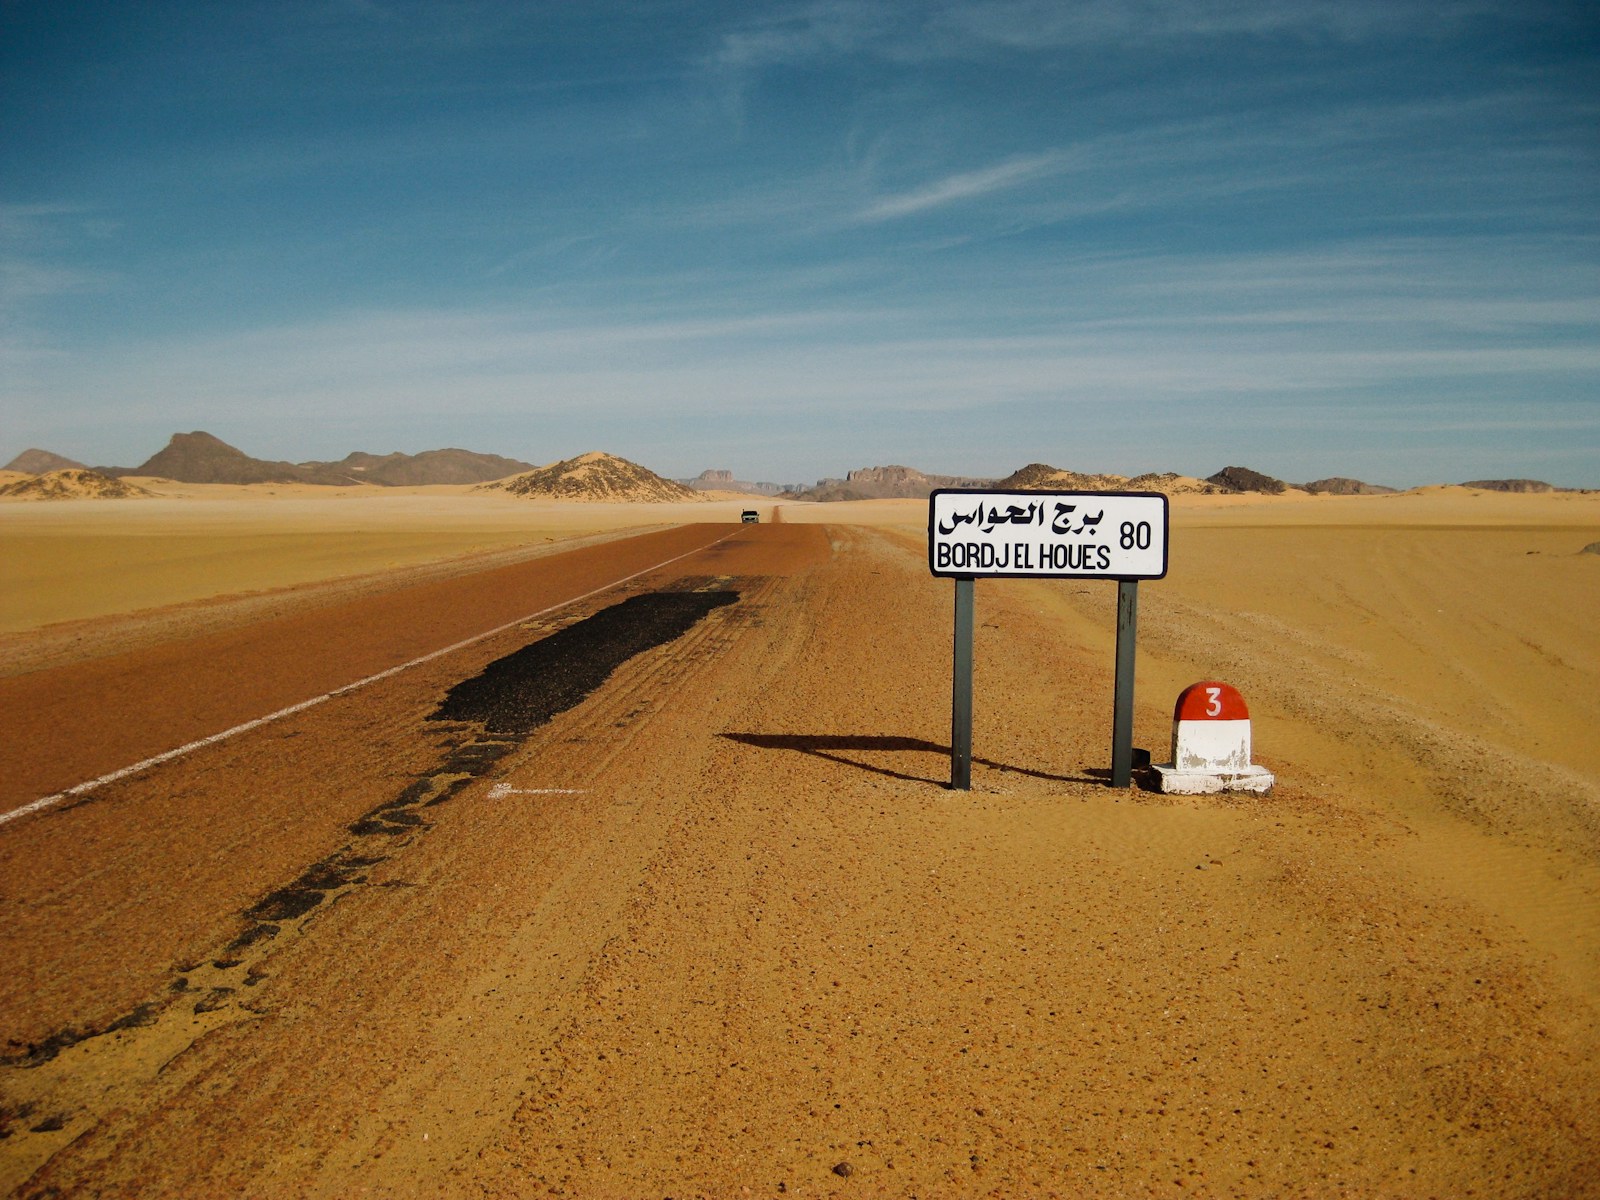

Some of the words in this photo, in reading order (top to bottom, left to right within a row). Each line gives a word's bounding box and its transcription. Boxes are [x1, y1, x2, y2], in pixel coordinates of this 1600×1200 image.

[938, 499, 1044, 536] الحواس
[1051, 500, 1104, 536] برج
[1119, 520, 1152, 550] 80
[937, 542, 1009, 568] BORDJ
[1014, 543, 1034, 569] EL
[1039, 543, 1111, 570] HOUES
[1205, 687, 1222, 717] 3
